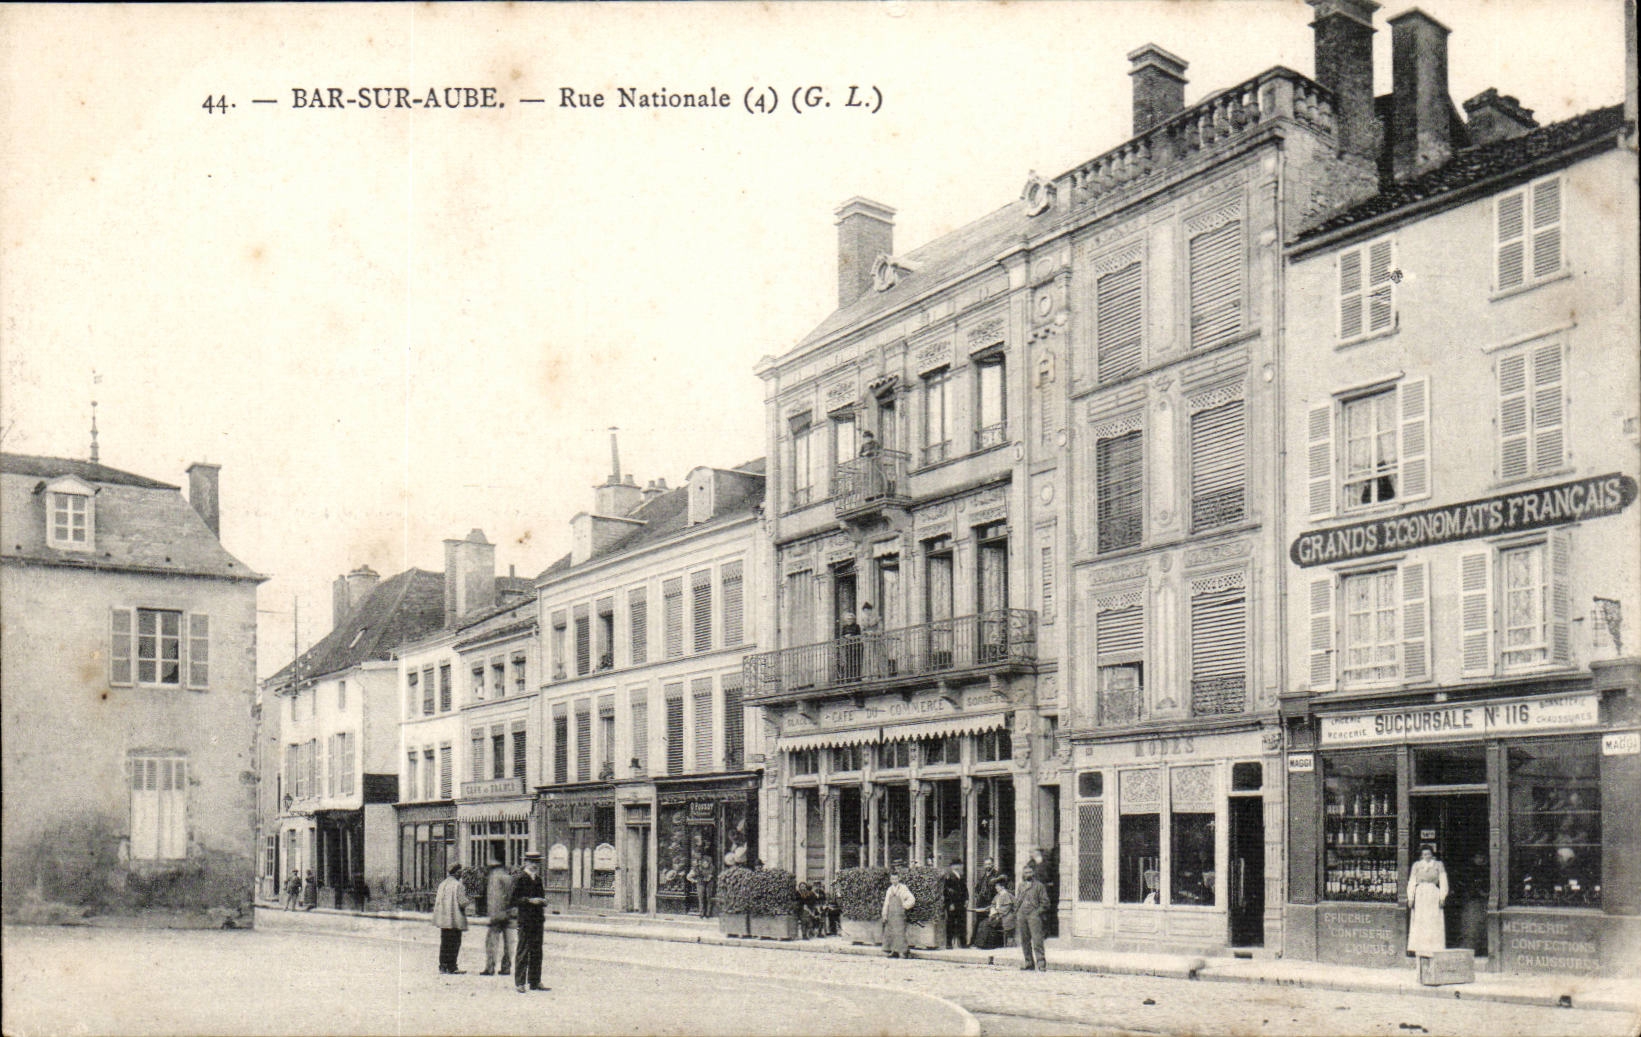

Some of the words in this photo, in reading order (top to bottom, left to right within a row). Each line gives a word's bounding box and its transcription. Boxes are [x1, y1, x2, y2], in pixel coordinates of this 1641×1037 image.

[1298, 526, 1379, 563] GRANDS
[1383, 501, 1502, 547] ECONOMATS
[1507, 478, 1621, 525] FRANÇAIS
[866, 707, 878, 719] DU
[890, 700, 945, 717] COMMERCE
[1374, 709, 1473, 735] SUCCURSALE
[1505, 704, 1530, 725] 116
[1605, 734, 1637, 750] MAGGI
[1289, 758, 1313, 768] MAGGI
[1331, 927, 1394, 940] CONFISERIE
[1502, 921, 1568, 937] MERCERIE
[1511, 937, 1597, 953] CONFECTIONS
